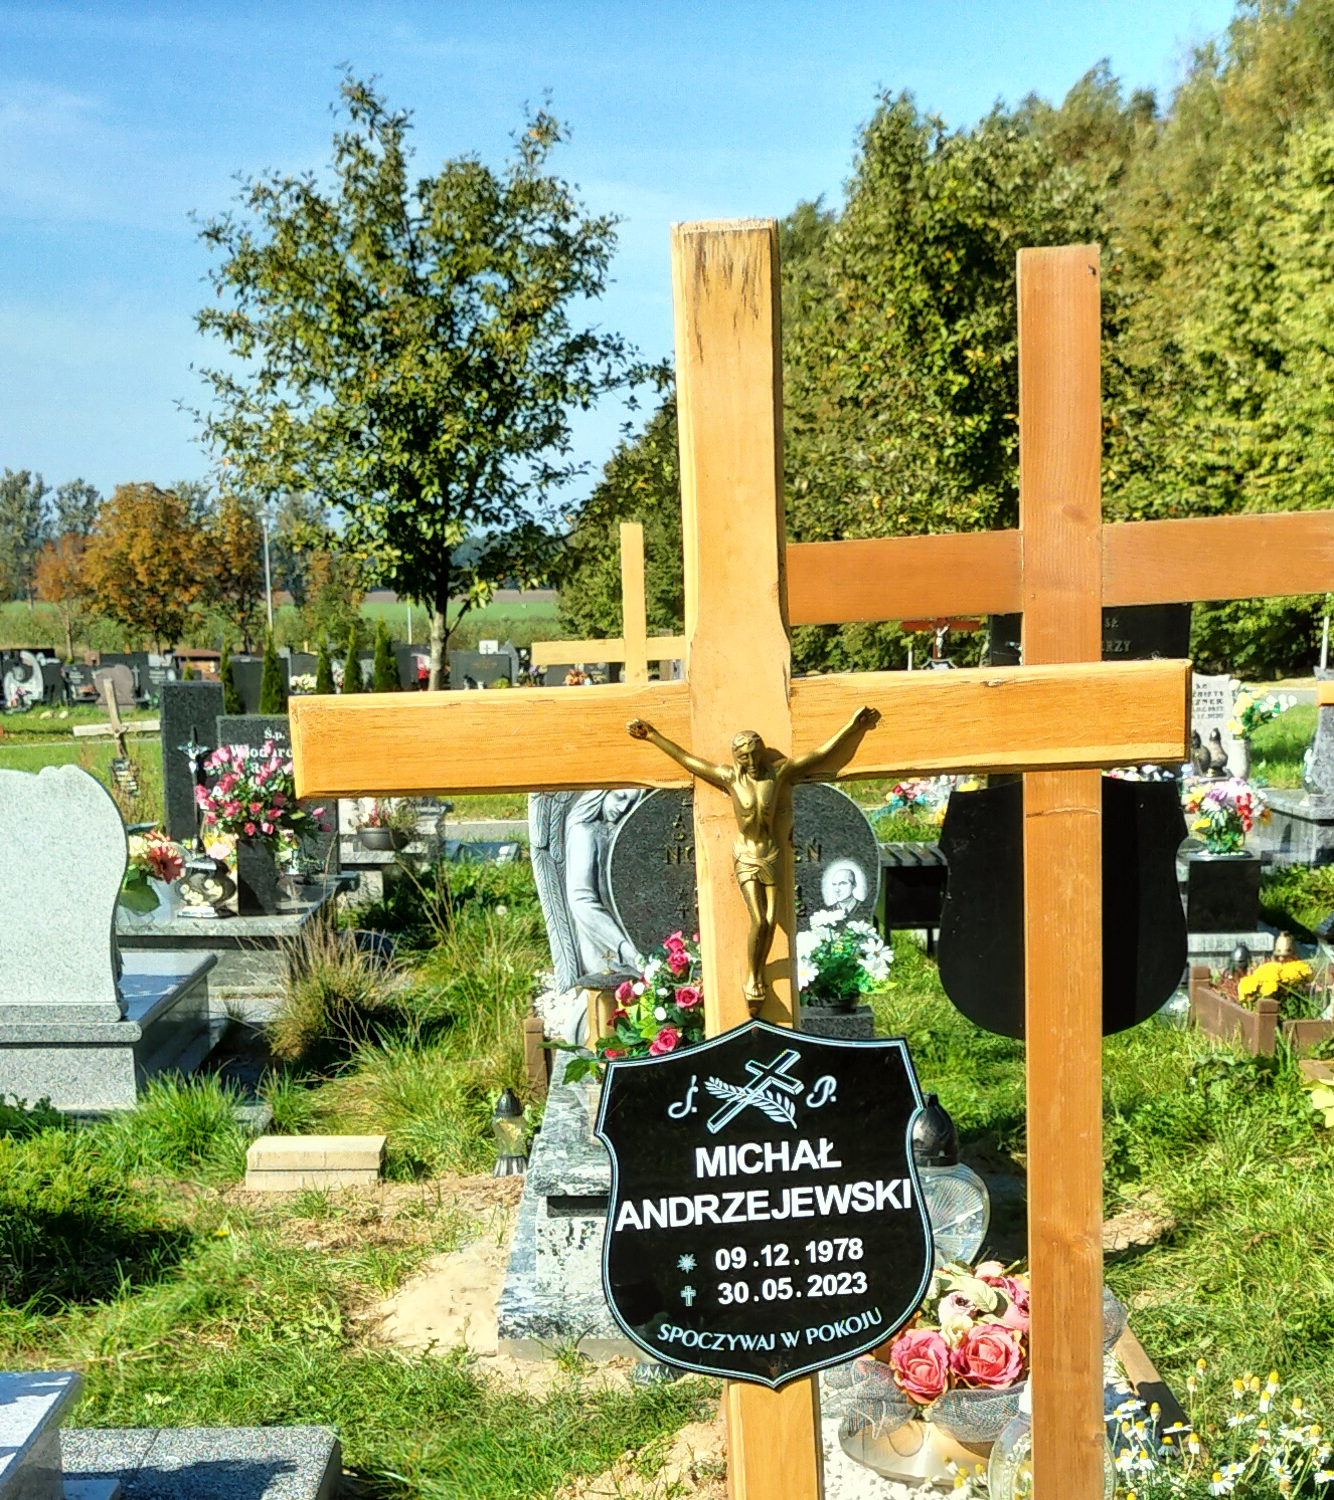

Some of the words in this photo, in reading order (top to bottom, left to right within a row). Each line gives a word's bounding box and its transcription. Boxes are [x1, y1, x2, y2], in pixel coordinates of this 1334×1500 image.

[694, 1138, 842, 1178] MICHAŁ
[615, 1178, 912, 1232] ANDRZEJEWSKI
[657, 1323, 776, 1351] SPOCZYWAJ
[780, 1330, 800, 1348] W
[806, 1307, 883, 1345] POKOJU
